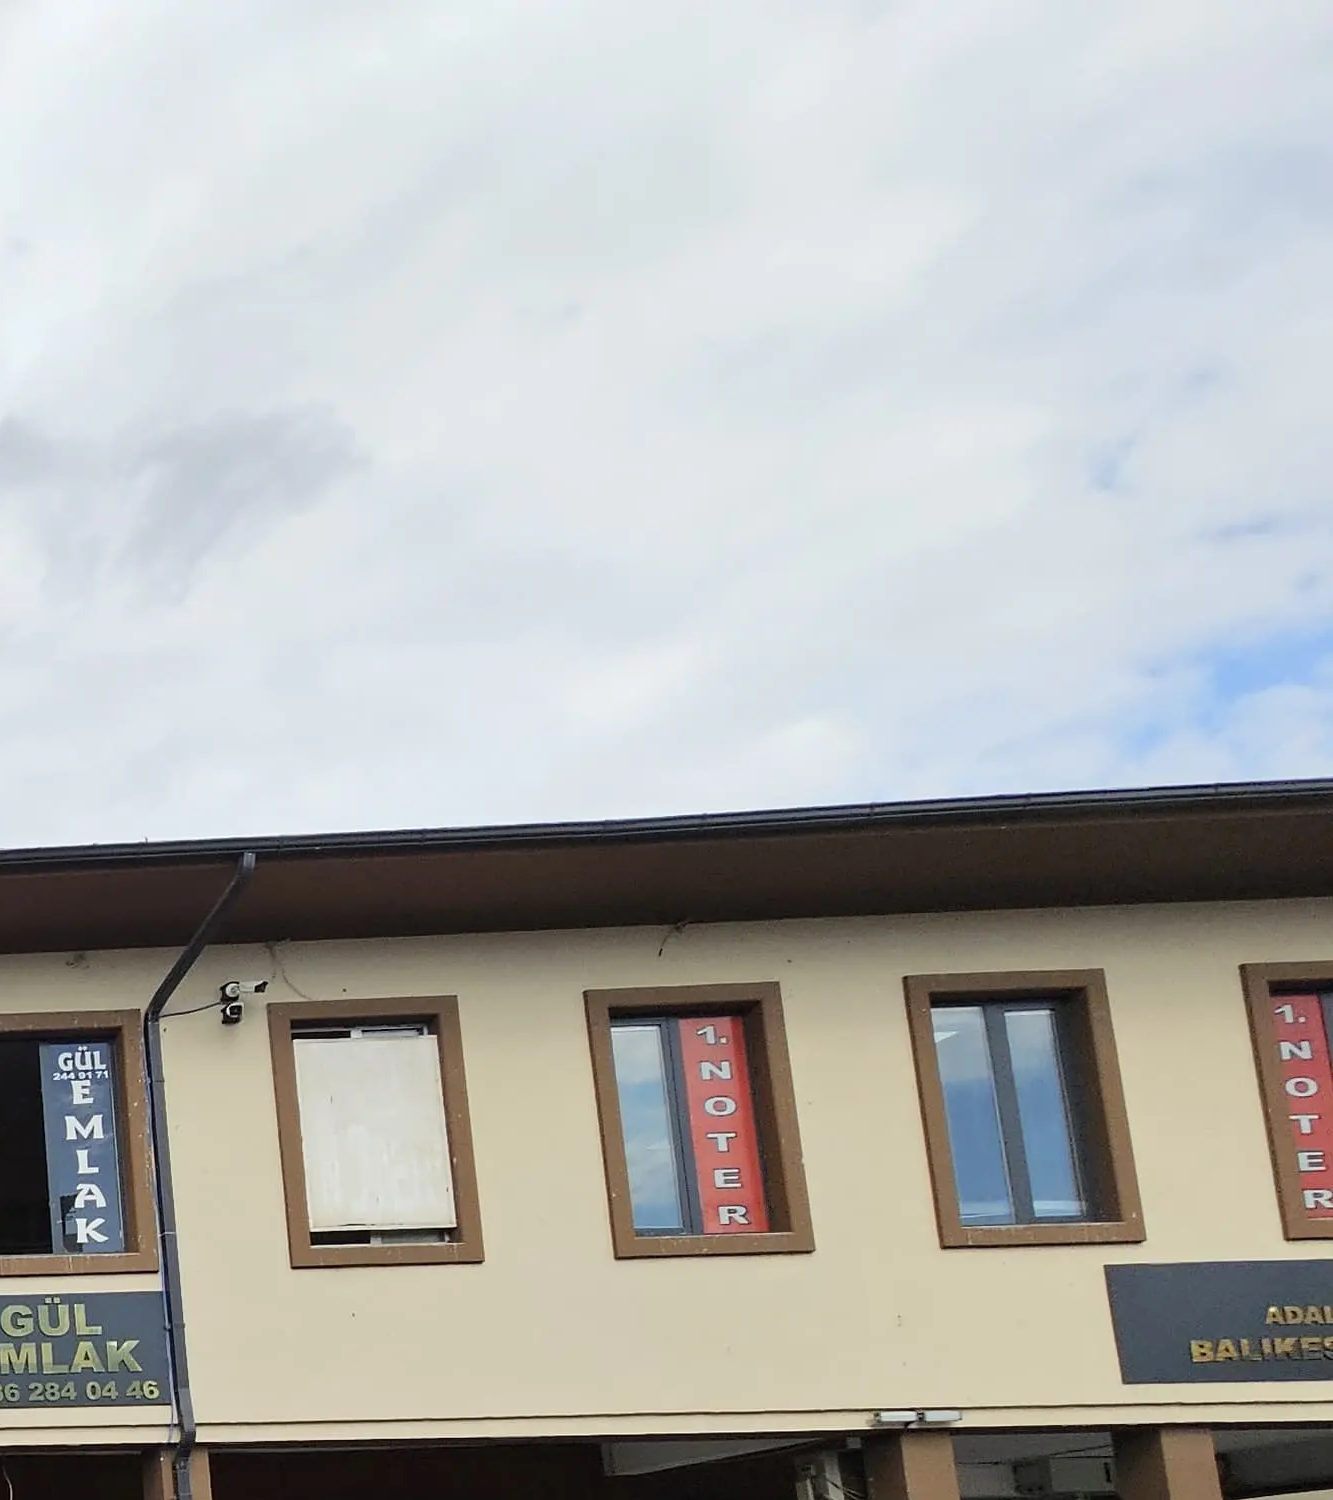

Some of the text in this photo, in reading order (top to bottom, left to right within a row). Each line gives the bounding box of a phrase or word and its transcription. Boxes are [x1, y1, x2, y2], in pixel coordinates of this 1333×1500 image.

[53, 1072, 79, 1081] 244
[96, 1071, 109, 1080] 71
[57, 1046, 107, 1072] GÜL
[695, 1025, 751, 1226] 1. NOTER
[1278, 1040, 1333, 1209] NOTER
[63, 1080, 110, 1244] EMLAK
[0, 1297, 103, 1337] GÜL
[28, 1381, 77, 1402] 284
[86, 1380, 118, 1401] 04
[125, 1379, 160, 1400] 46
